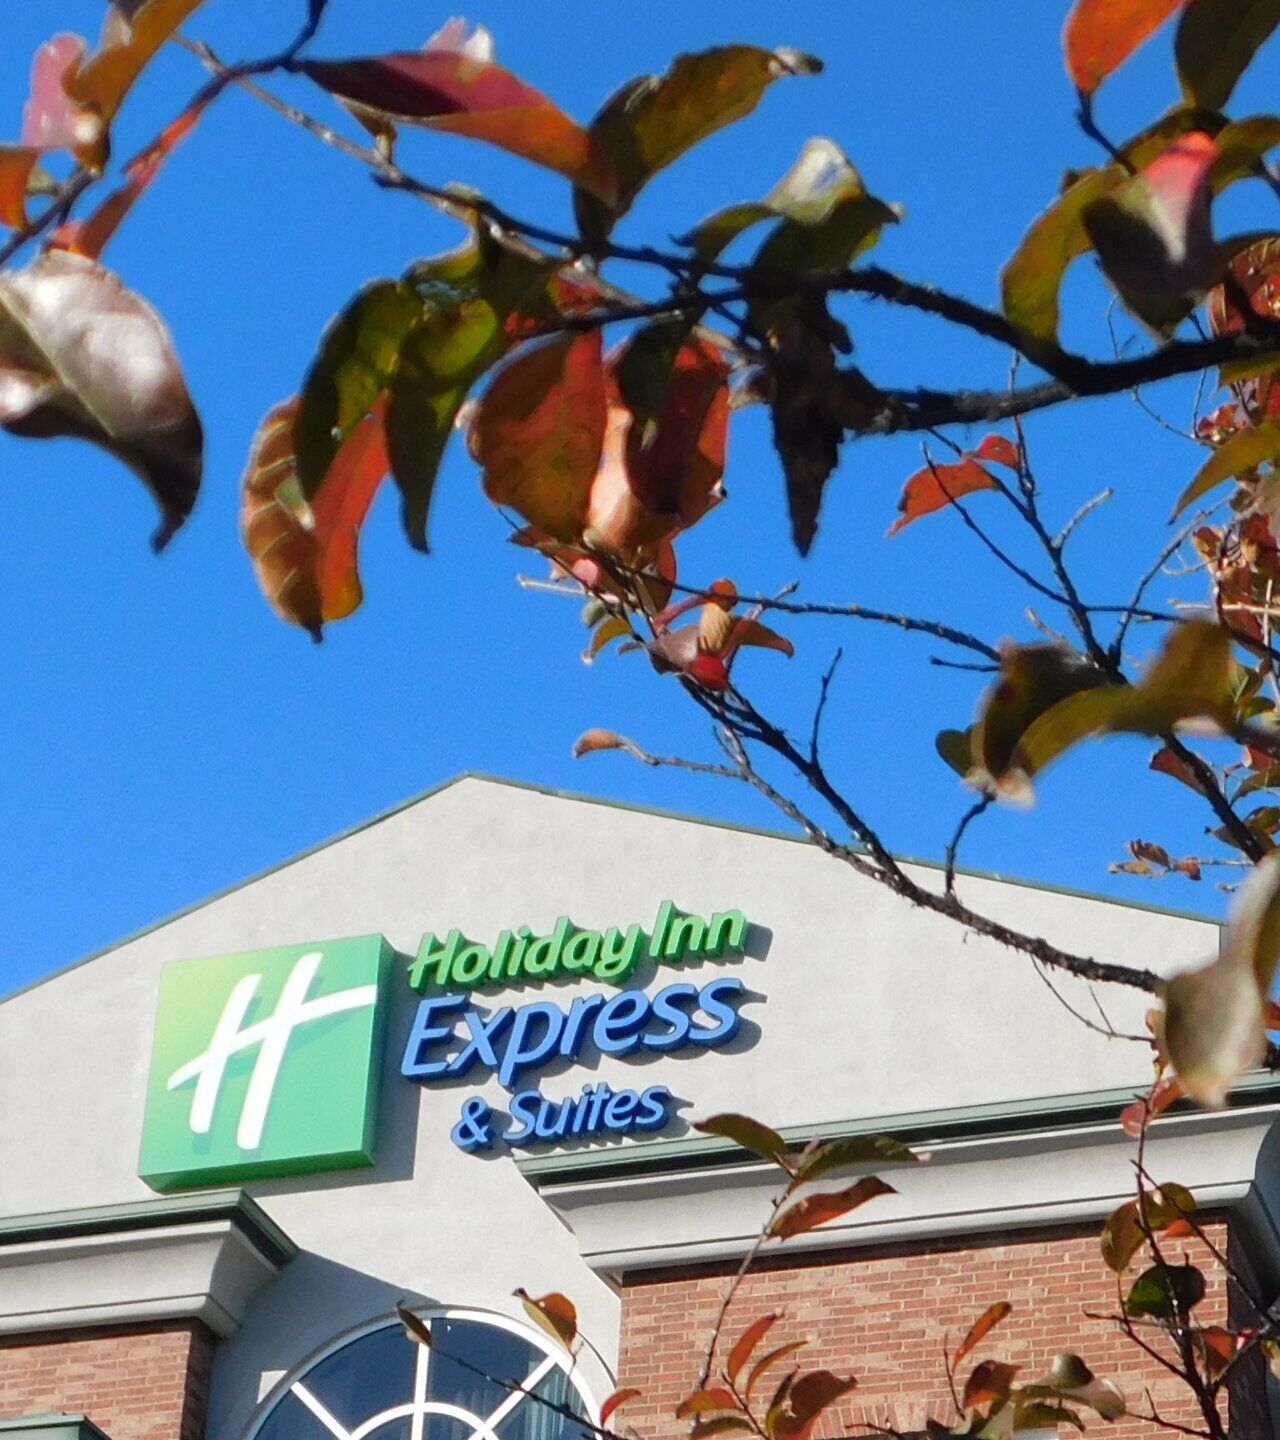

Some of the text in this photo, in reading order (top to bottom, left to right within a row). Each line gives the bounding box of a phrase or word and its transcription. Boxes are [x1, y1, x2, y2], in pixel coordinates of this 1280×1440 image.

[407, 899, 749, 988] Holiday Inn
[400, 976, 745, 1087] Express
[450, 1082, 672, 1154] & Suites
